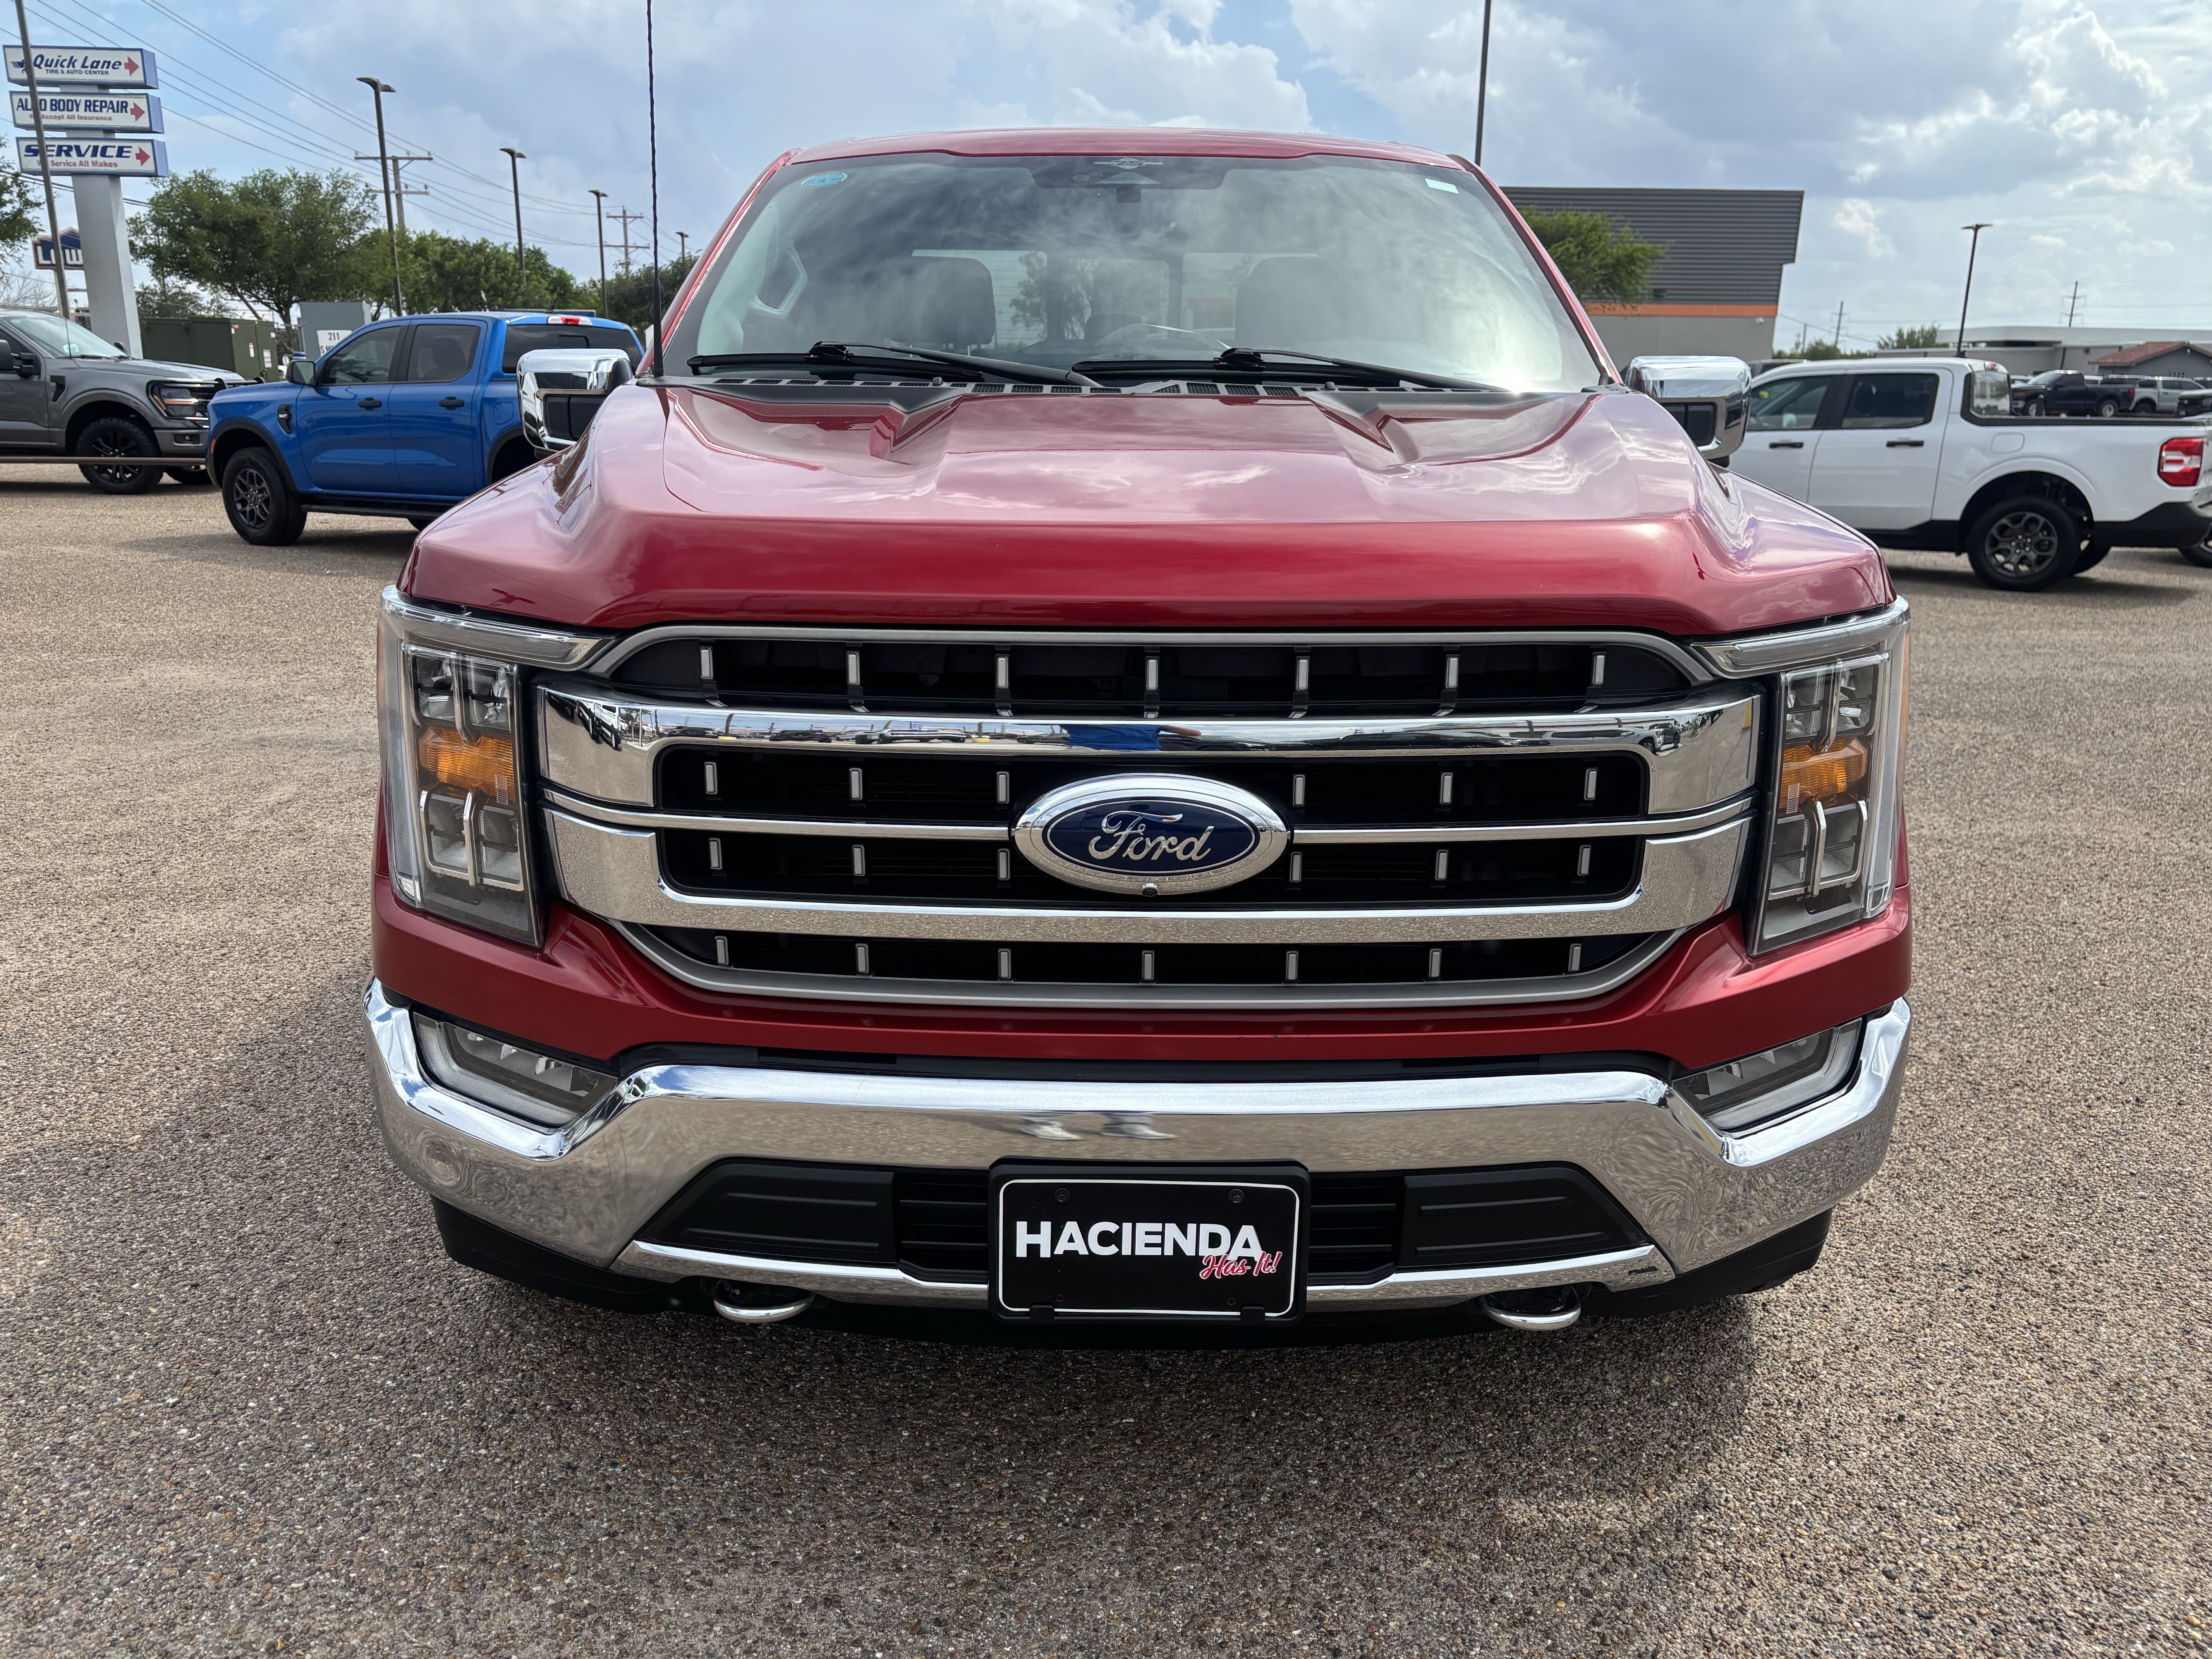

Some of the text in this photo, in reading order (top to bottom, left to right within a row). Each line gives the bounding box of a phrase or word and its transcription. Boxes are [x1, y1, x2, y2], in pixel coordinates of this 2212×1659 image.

[33, 54, 122, 70] Quick Lane
[16, 98, 128, 113] AUO BODY REPAIR
[24, 144, 132, 158] SERVICE
[328, 332, 340, 341] 211
[1088, 810, 1215, 861] Ford
[1015, 1221, 1263, 1262] HACIENDA
[1199, 1250, 1283, 1279] Has It!
